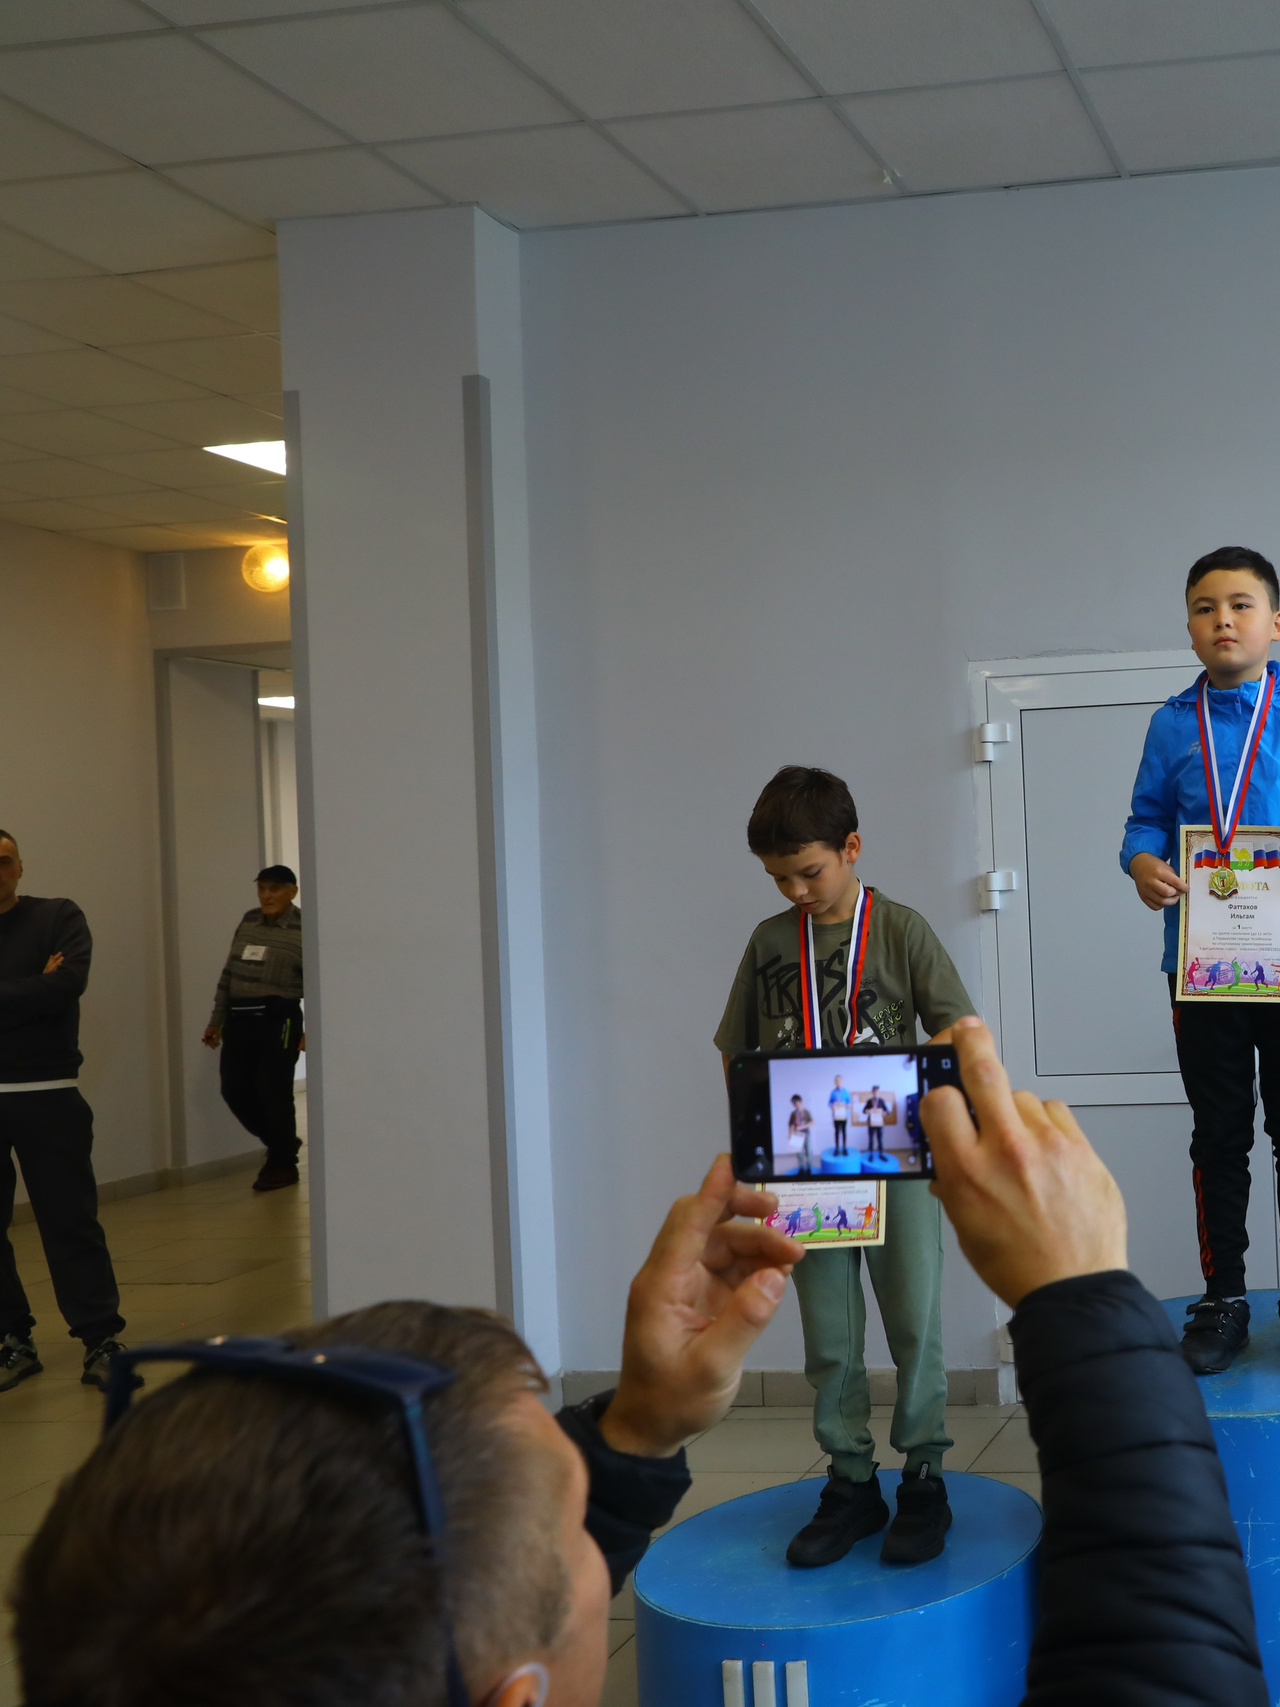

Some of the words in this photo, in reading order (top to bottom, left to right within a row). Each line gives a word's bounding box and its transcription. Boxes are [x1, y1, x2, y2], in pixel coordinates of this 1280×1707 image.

[1220, 879, 1226, 888] 1
[1228, 903, 1258, 911] Фаттахов
[1230, 912, 1255, 920] Ильгам
